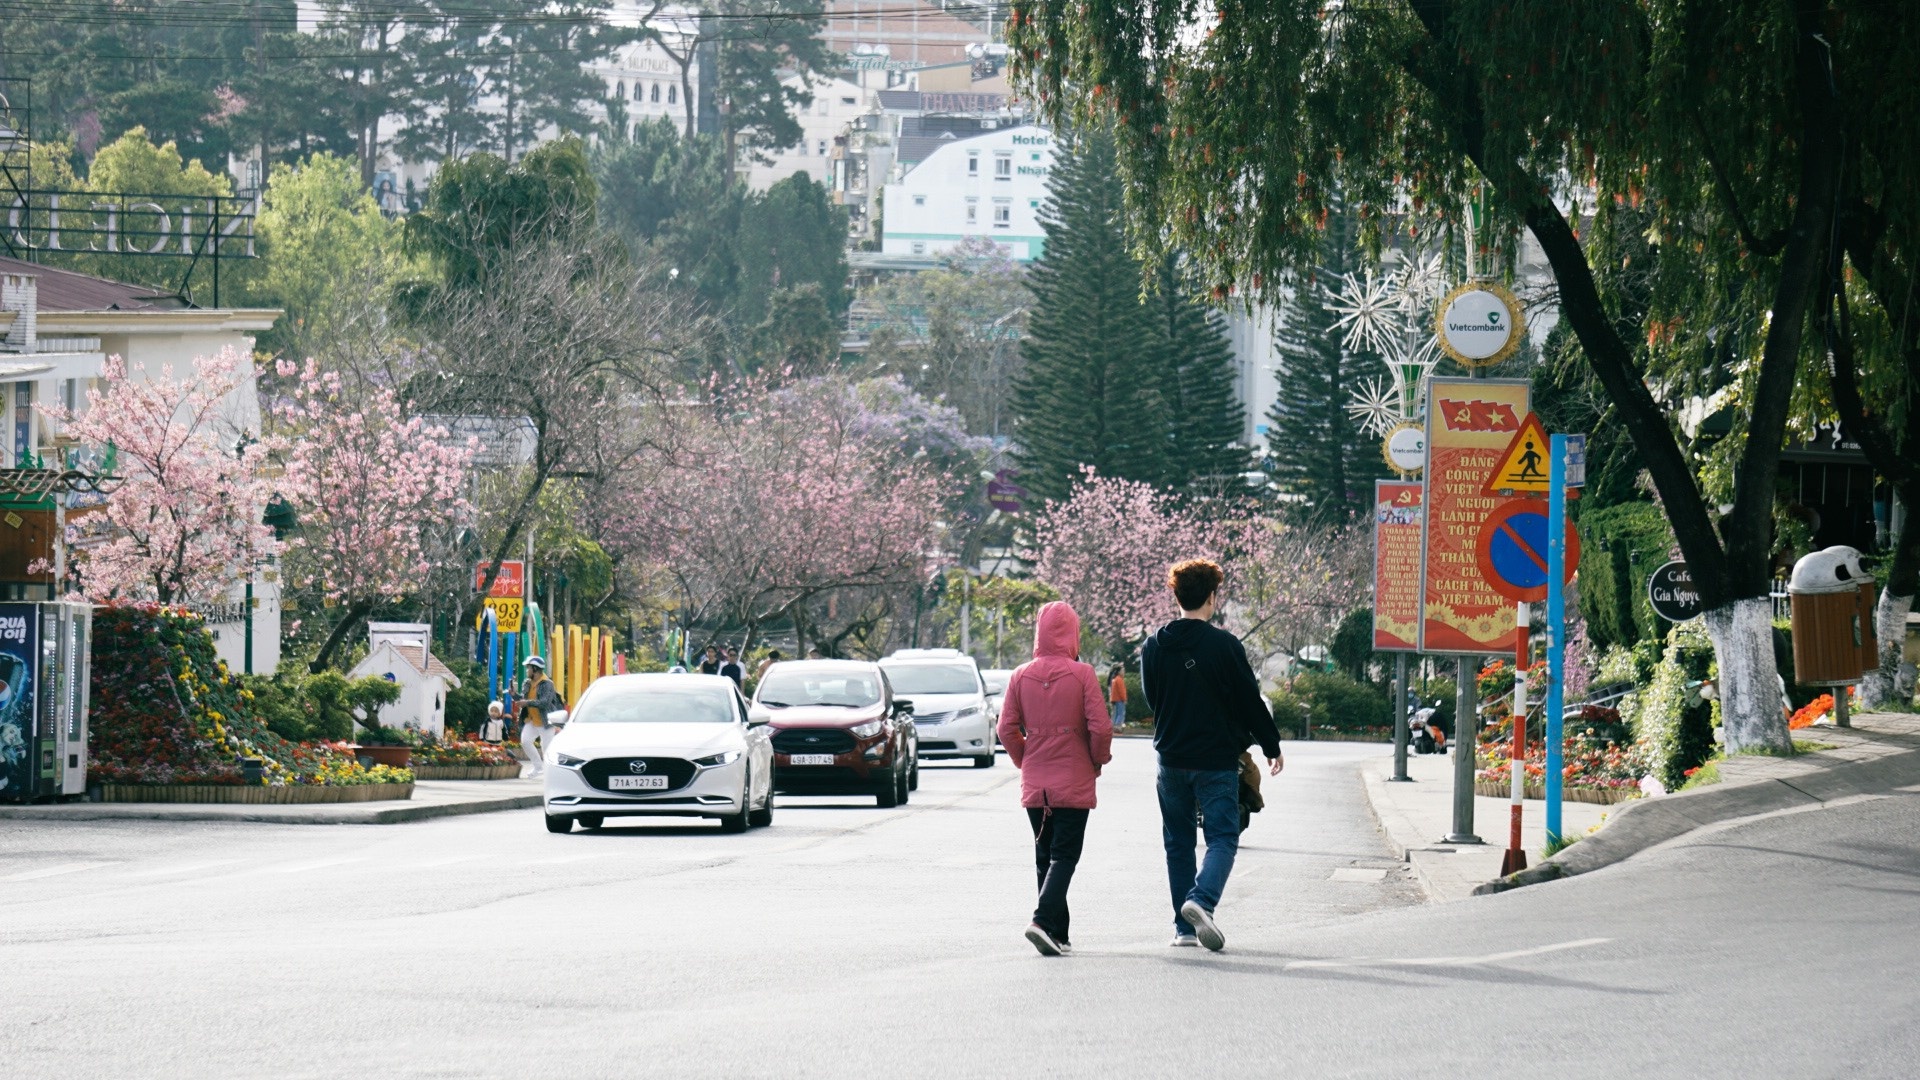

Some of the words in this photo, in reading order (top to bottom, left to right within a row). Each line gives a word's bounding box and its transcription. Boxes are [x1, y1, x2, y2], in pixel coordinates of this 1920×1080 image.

[1012, 134, 1048, 146] Hotel
[1449, 323, 1505, 332] Vietcombank
[1445, 468, 1480, 482] CỘNG
[1445, 482, 1475, 497] VIỆT
[1435, 577, 1469, 591] CÁCH
[1441, 592, 1471, 607] VIỆT
[1474, 594, 1504, 606] NAM
[1653, 586, 1671, 602] Gia
[614, 778, 664, 787] 71A-127.63
